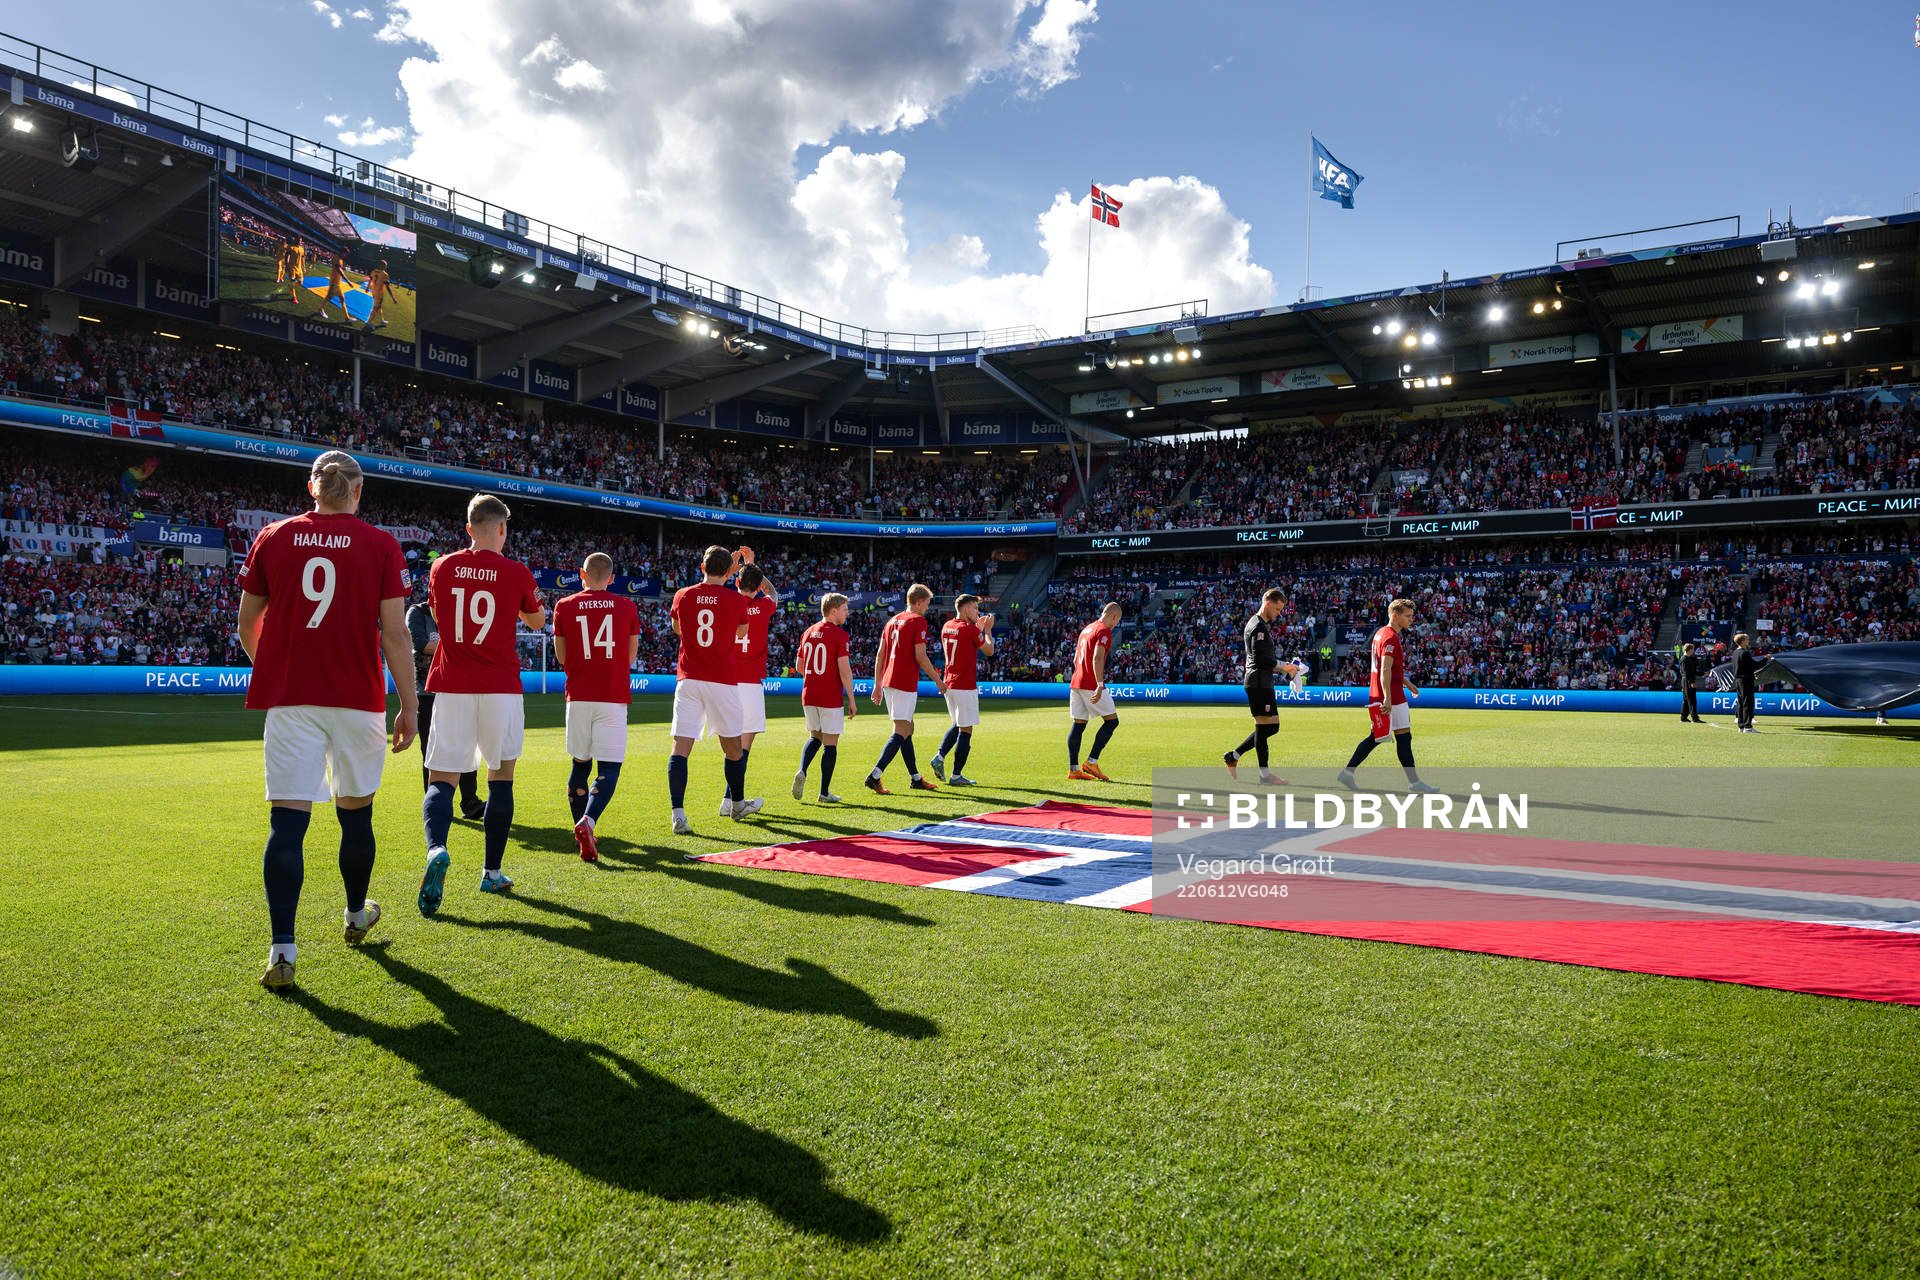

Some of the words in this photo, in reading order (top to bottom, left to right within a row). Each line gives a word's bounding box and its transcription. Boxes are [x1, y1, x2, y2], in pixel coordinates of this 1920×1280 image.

[37, 88, 75, 110] bama
[113, 112, 147, 134] bama
[182, 136, 215, 155] bama
[0, 248, 43, 271] ma
[428, 344, 468, 367] bama
[1547, 345, 1576, 356] Tipping
[535, 365, 570, 391] bama
[626, 391, 656, 410] bama
[62, 414, 99, 429] PEACE
[756, 410, 790, 428] bama
[834, 420, 867, 437] bama
[879, 425, 914, 437] bama
[963, 422, 1000, 435] bama
[235, 440, 267, 453] PEACE
[378, 462, 404, 474] PEACE
[498, 481, 521, 492] PEACE
[1818, 500, 1867, 513] PEACE
[5, 520, 45, 533] ALT
[56, 524, 94, 538] FOR
[159, 526, 202, 545] bama
[1403, 522, 1439, 534] PEACE
[294, 533, 350, 548] HAALAND
[1092, 538, 1120, 548] PEACE
[1237, 531, 1268, 542] PEACE
[455, 566, 497, 582] SØRLOTH
[302, 557, 336, 628] 9
[579, 600, 614, 610] RYERSON
[697, 596, 718, 605] BERGE
[451, 587, 496, 645] 19
[697, 609, 714, 647] 8
[576, 614, 615, 660] 14
[735, 634, 750, 653] 4
[804, 643, 827, 675] 20
[944, 638, 958, 665] 17
[146, 672, 201, 687] PEACE
[854, 683, 867, 693] ACE
[1275, 690, 1311, 701] PEACE
[1475, 693, 1517, 705] PEACE
[1713, 697, 1763, 709] PEAE
